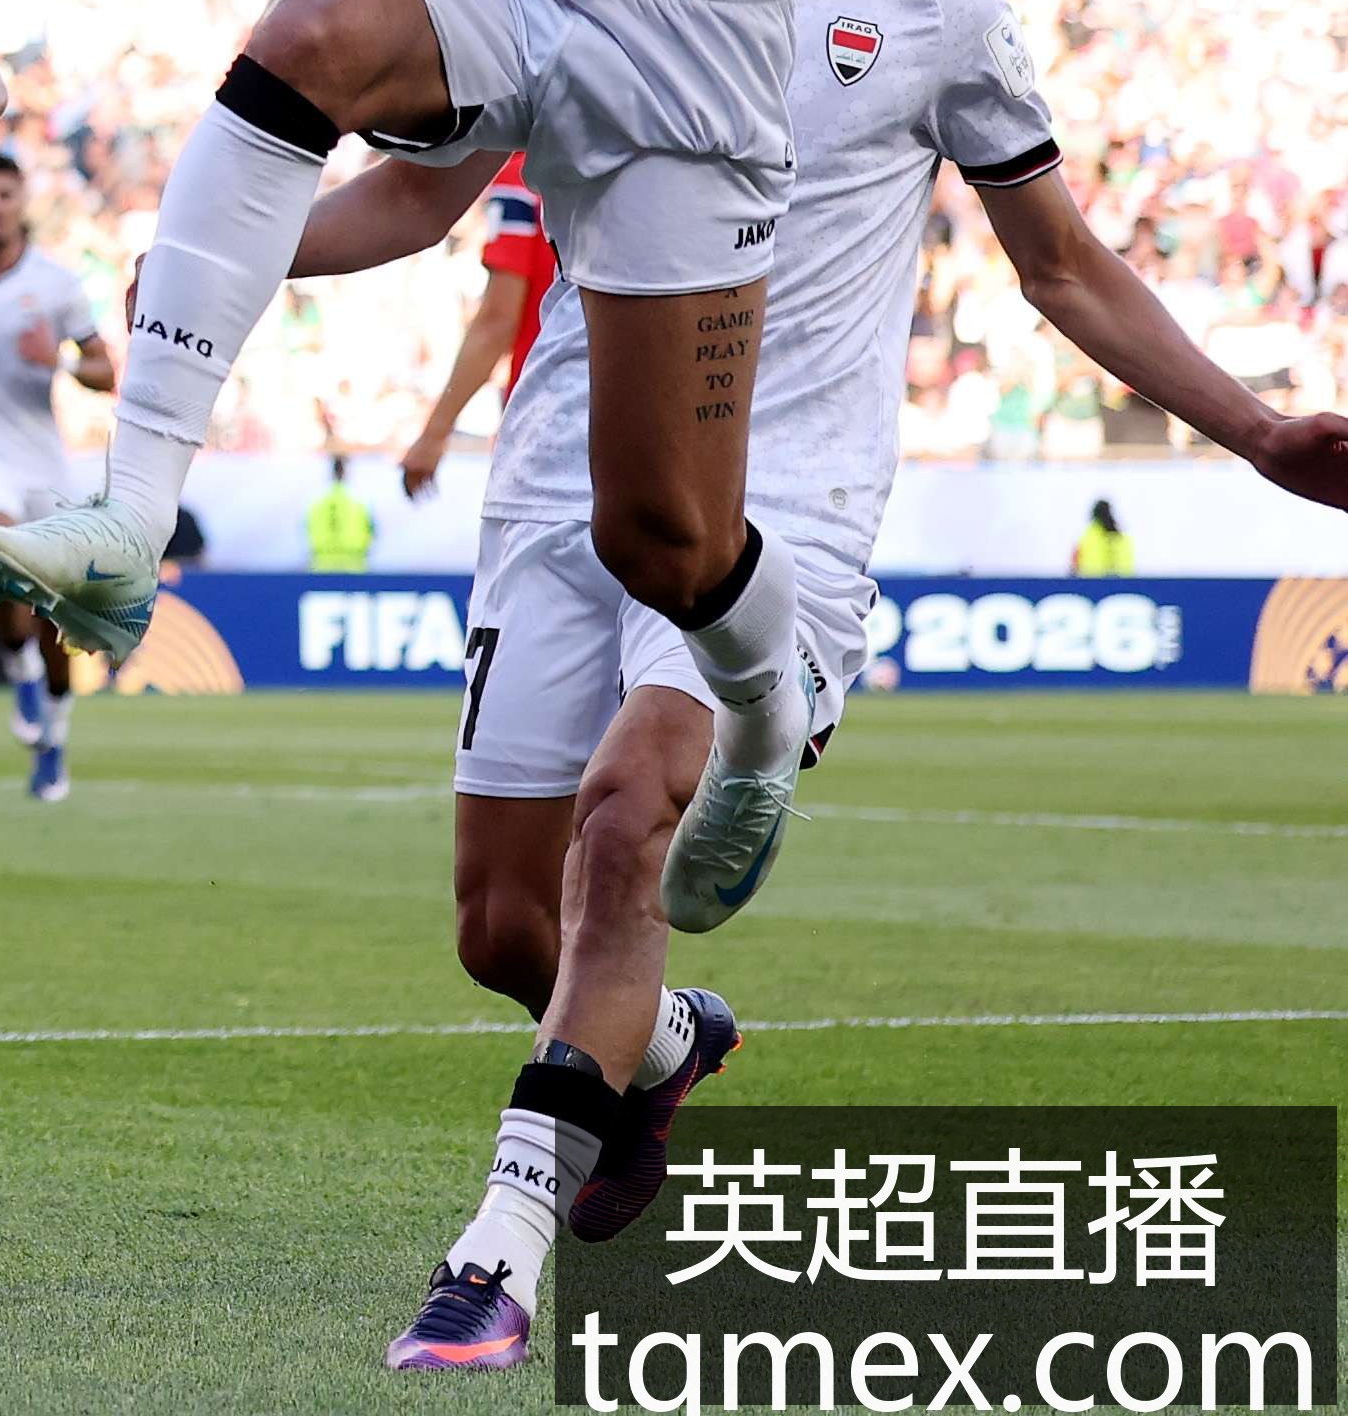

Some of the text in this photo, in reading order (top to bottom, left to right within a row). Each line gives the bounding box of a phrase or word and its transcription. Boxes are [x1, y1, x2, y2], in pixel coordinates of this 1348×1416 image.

[841, 21, 873, 34] IRAQ
[734, 217, 776, 250] JAKO
[696, 308, 754, 333] GAME
[134, 313, 214, 359] JAKO
[695, 338, 750, 363] PLAY
[705, 372, 735, 391] TO
[695, 401, 736, 424] WIN
[297, 590, 466, 672] FIFA
[903, 591, 1158, 673] 2026
[462, 626, 501, 751] 7
[491, 1157, 561, 1196] JAKO
